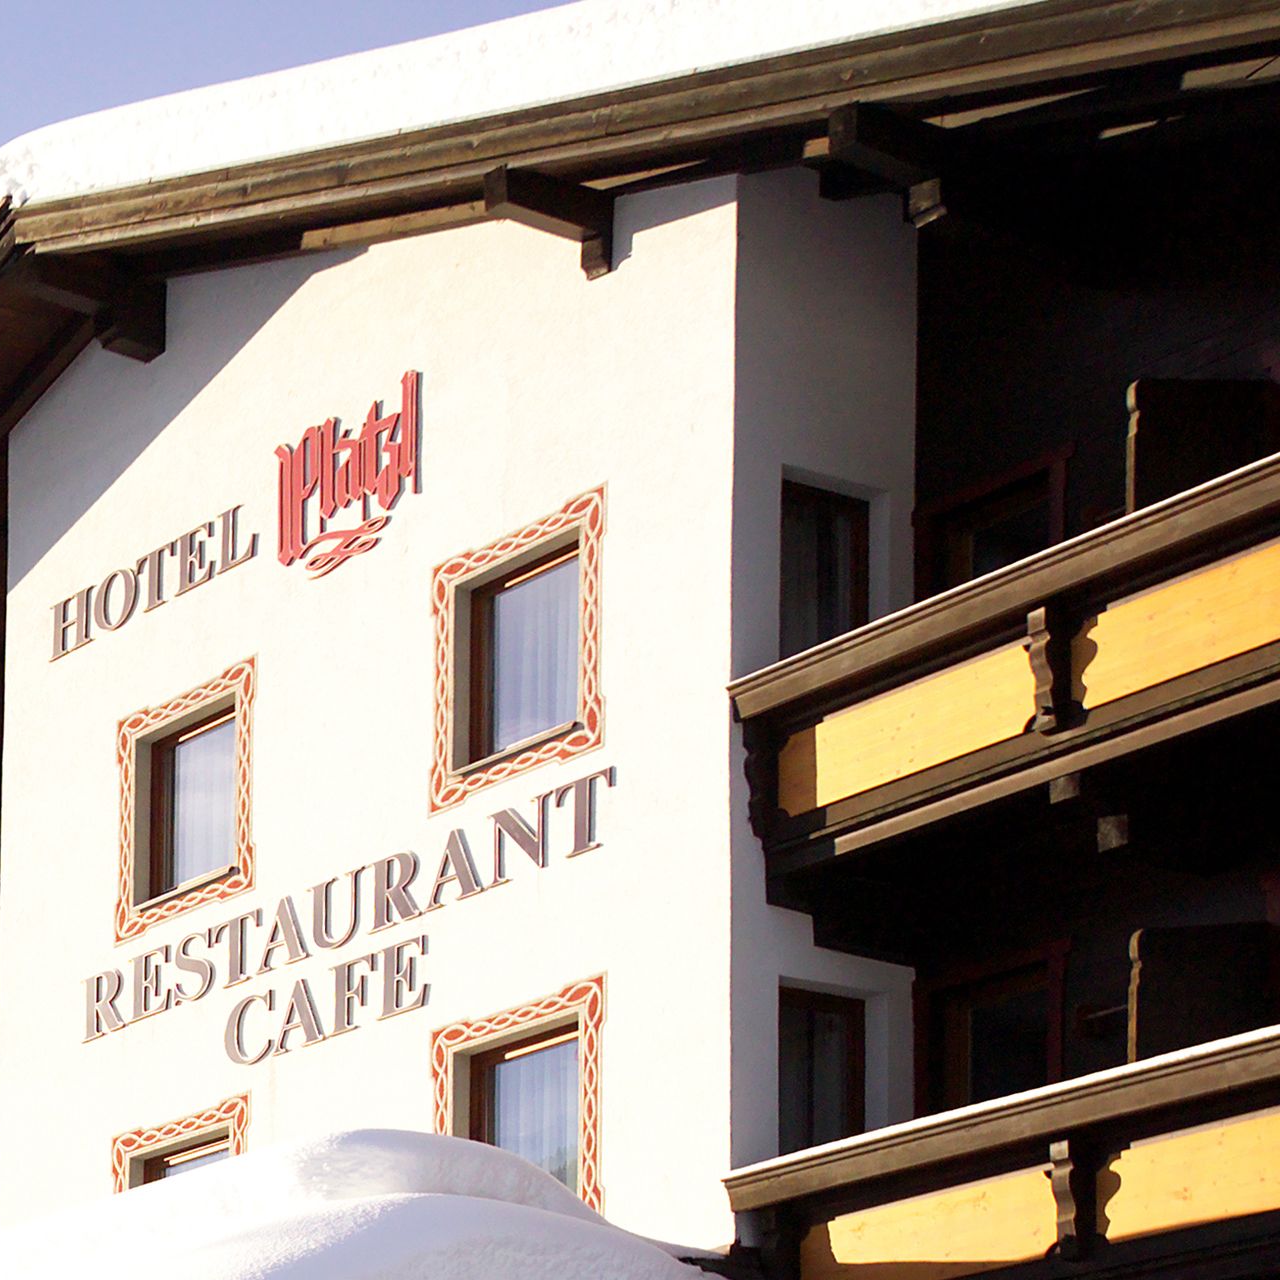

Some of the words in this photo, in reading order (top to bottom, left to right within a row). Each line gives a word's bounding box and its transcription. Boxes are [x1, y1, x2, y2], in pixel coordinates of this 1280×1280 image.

[48, 503, 260, 662] HOTEL
[83, 766, 615, 1044] RESTAURANT
[223, 933, 432, 1066] CAFE
